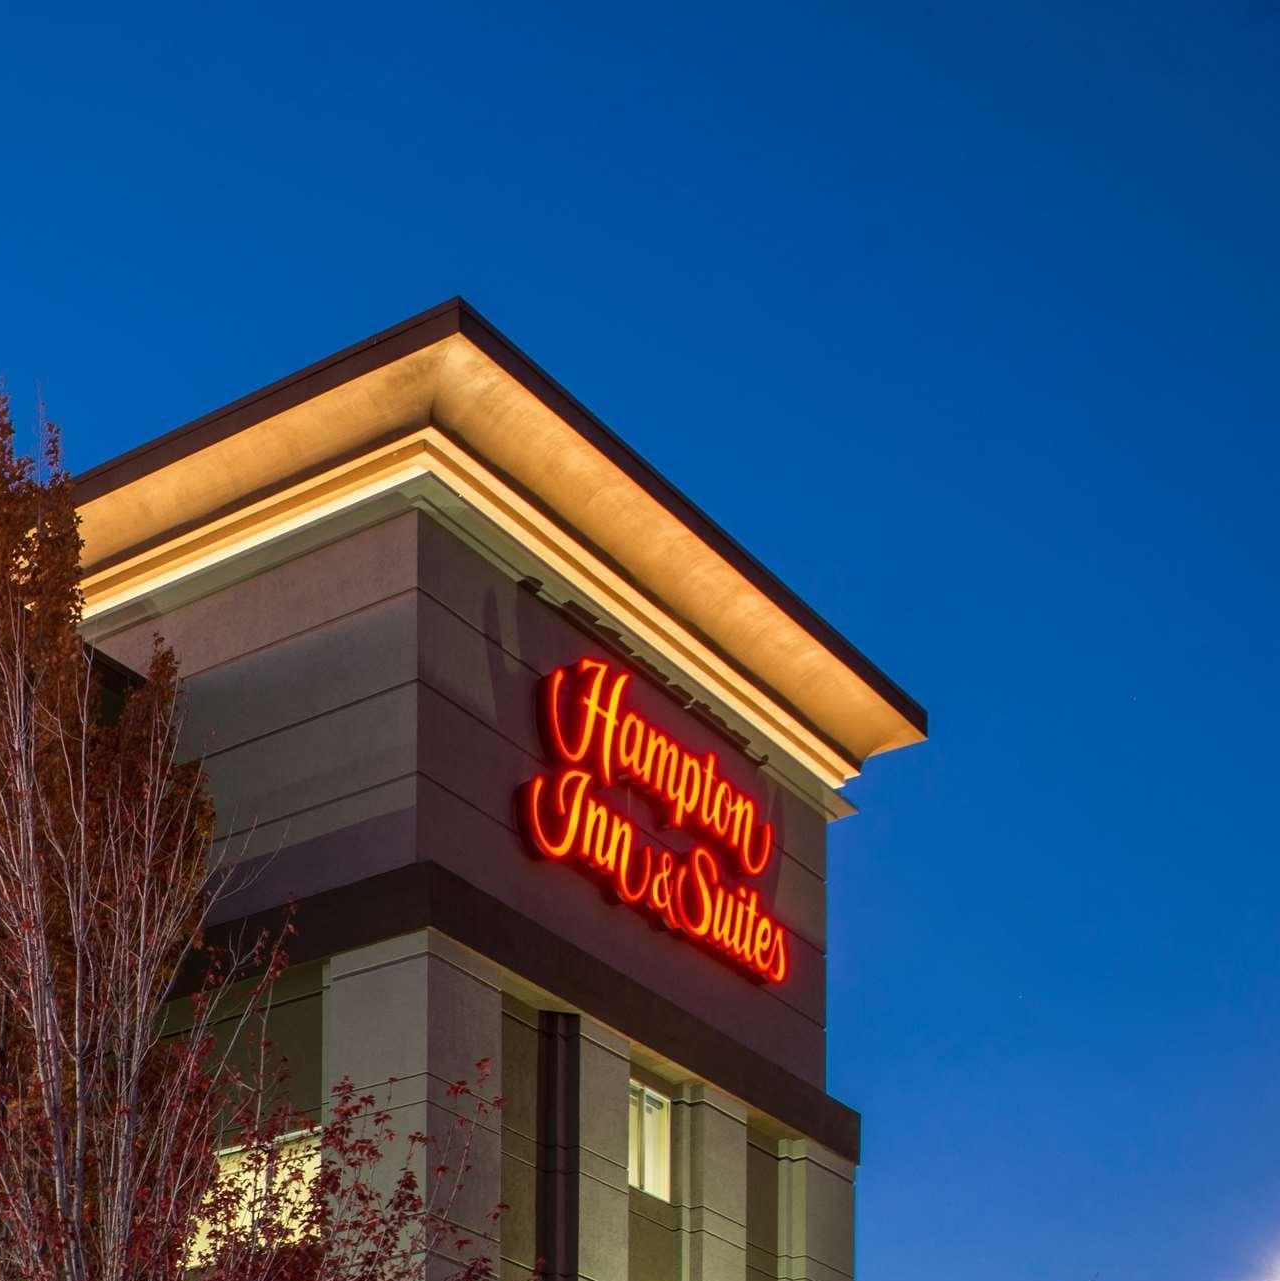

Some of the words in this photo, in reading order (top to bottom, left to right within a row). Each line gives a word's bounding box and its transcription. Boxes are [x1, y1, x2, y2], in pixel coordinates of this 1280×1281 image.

[551, 658, 773, 876] Hampton
[532, 769, 652, 902] Inn
[652, 852, 679, 929] &
[677, 848, 787, 983] Suites
